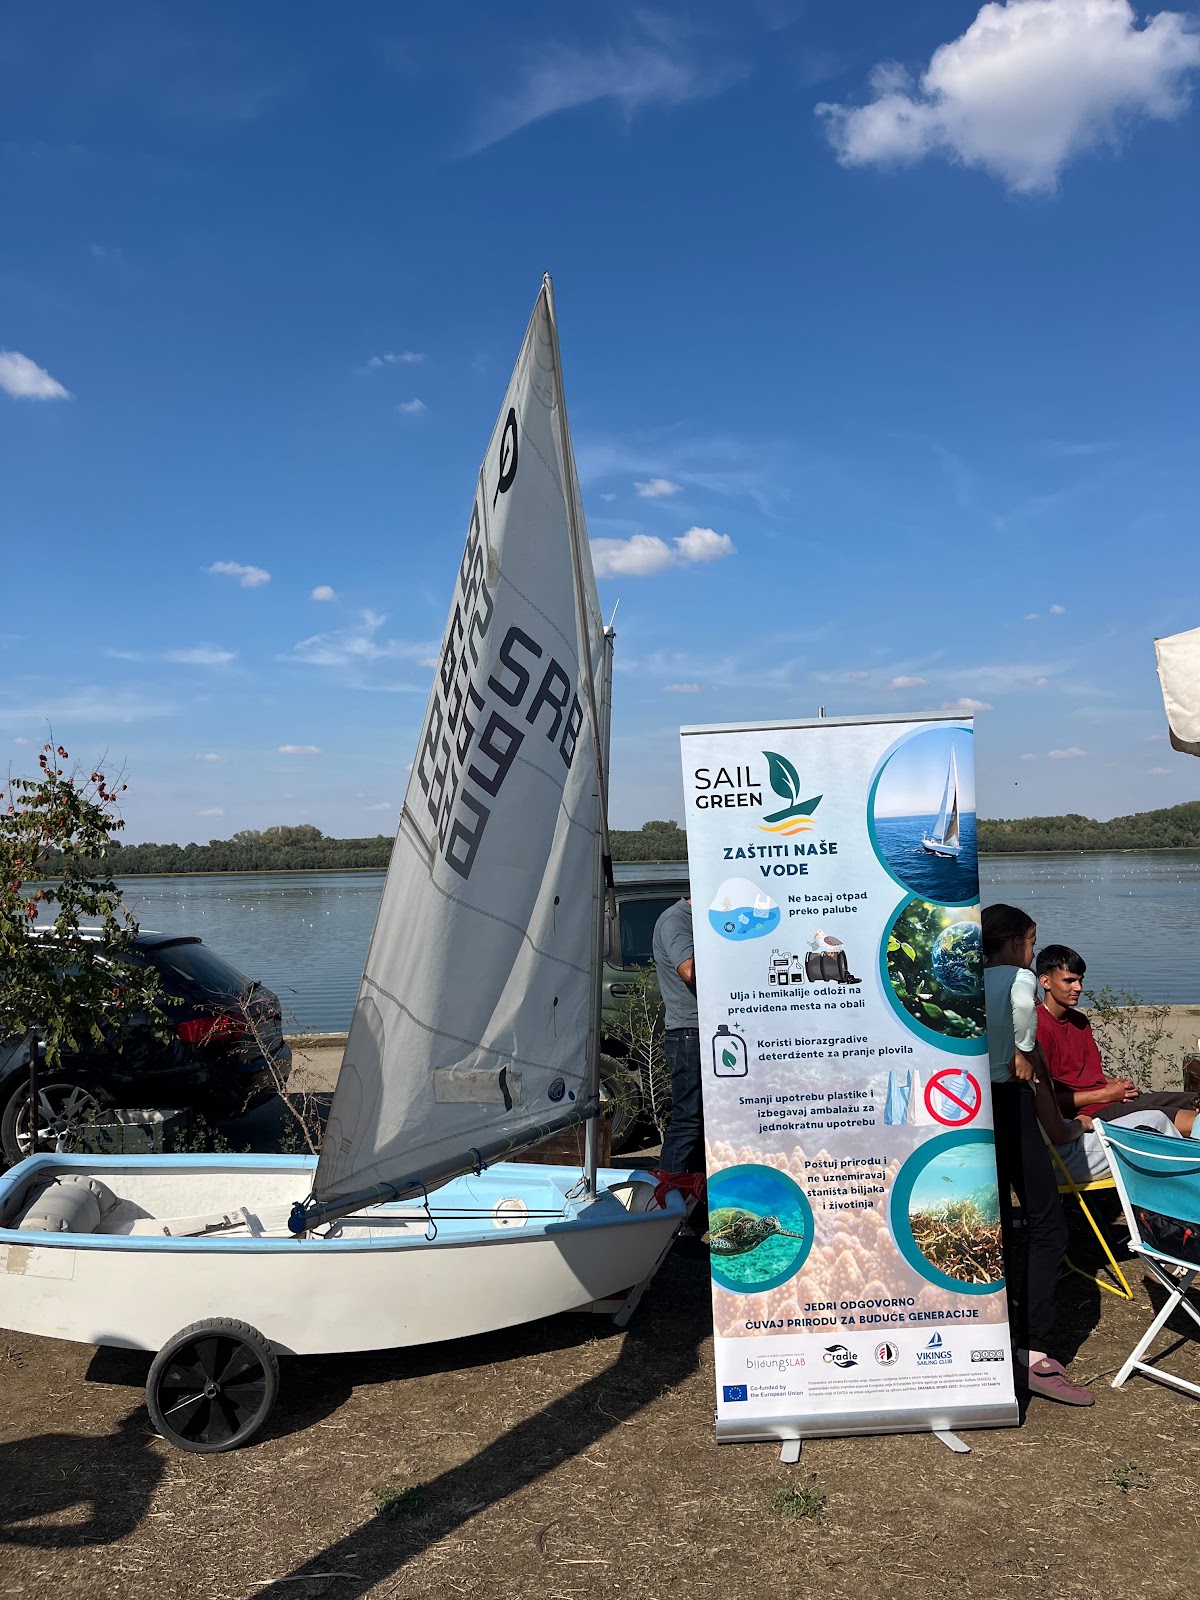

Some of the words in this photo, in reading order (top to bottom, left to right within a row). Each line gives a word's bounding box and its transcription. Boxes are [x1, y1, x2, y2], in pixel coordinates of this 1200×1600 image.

[488, 626, 584, 770] SRB
[694, 766, 761, 790] SAIL
[695, 792, 762, 809] GREEN
[723, 843, 788, 860] ZAŠTITI
[794, 840, 838, 856] NAŠE
[760, 863, 808, 877] VODE
[804, 892, 832, 904] bacaj
[836, 892, 868, 901] otpad
[789, 906, 819, 917] preko
[822, 906, 858, 916] palube
[730, 991, 750, 1001] Ulja
[752, 990, 755, 999] i
[758, 988, 810, 999] hemikalije
[814, 986, 846, 996] odloži
[849, 987, 861, 995] na
[728, 1004, 787, 1016] predviđena
[790, 1003, 821, 1011] mesta
[840, 1000, 865, 1009] obali
[758, 1038, 792, 1048] Koristi
[795, 1035, 868, 1048] biorazgradive
[758, 1050, 824, 1061] deterdžente
[842, 1047, 875, 1059] pranje
[878, 1046, 913, 1057] plovila
[739, 1094, 773, 1105] Smanji
[775, 1092, 824, 1104] upotrebu
[828, 1090, 868, 1102] plastike
[870, 1090, 874, 1098] i
[757, 1106, 807, 1118] izbegavaj
[810, 1103, 860, 1115] ambalažu
[863, 1104, 874, 1112] za
[758, 1121, 824, 1134] jednokratnu
[826, 1118, 875, 1130] upotrebu
[804, 1158, 838, 1170] Poštuj
[840, 1156, 881, 1168] prirodu
[884, 1157, 887, 1165] i
[807, 1175, 819, 1183] ne
[823, 1171, 886, 1182] uznemiravaj
[807, 1185, 847, 1197] staništa
[850, 1184, 885, 1196] biljaka
[823, 1202, 826, 1210] i
[829, 1199, 874, 1211] životinja
[804, 1302, 836, 1312] JEDRI
[840, 1298, 915, 1310] ODGOVORNO
[745, 1318, 784, 1330] ČUVAJ
[787, 1316, 837, 1328] PRIRODU
[841, 1316, 855, 1325] ZA
[859, 1311, 905, 1323] BUDUĆE
[908, 1309, 979, 1321] GENERACIJE
[823, 1352, 858, 1363] Cradle
[916, 1351, 952, 1360] VIKINGS
